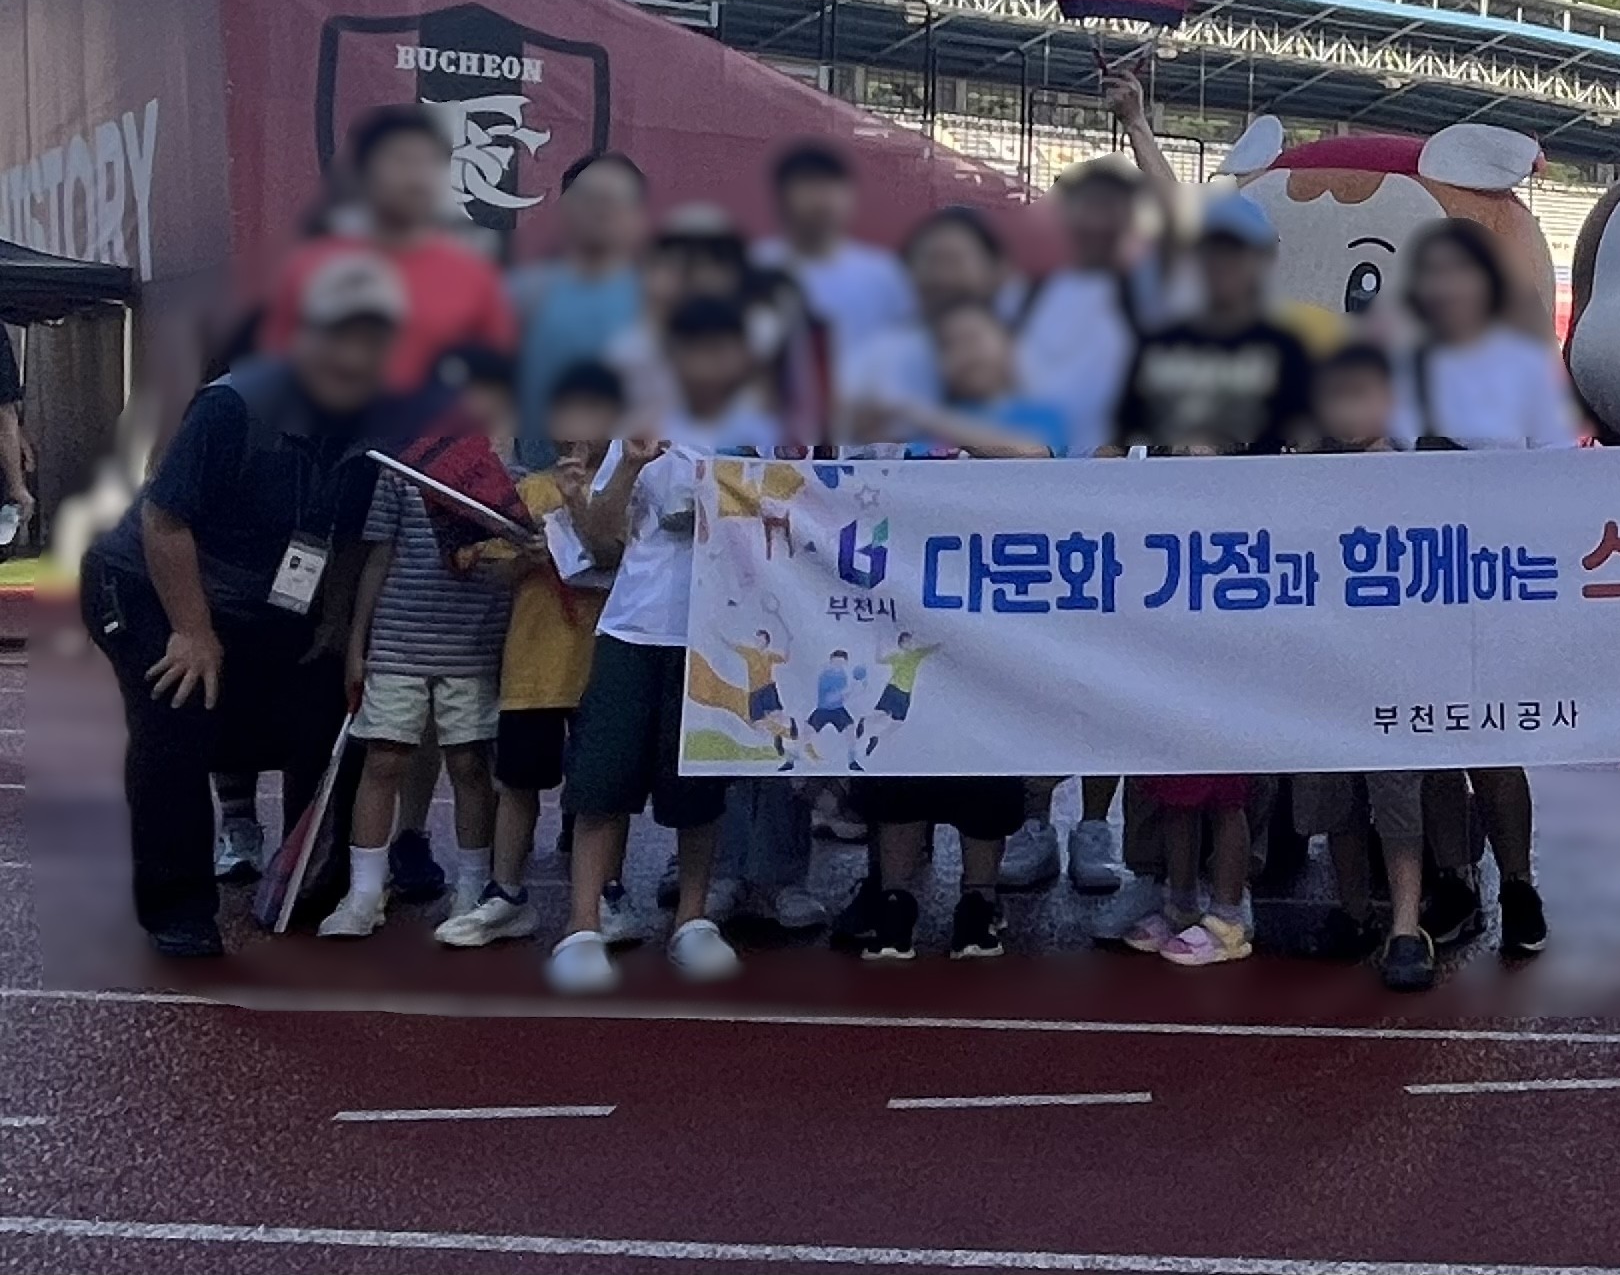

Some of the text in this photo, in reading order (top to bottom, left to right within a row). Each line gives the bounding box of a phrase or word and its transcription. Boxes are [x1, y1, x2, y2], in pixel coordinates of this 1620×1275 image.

[395, 44, 544, 84] BUCHEON
[923, 531, 1122, 613] 다문화
[1144, 528, 1320, 612] 가정과
[1339, 524, 1559, 608] 함께하는
[826, 596, 896, 622] 부천시
[1374, 700, 1579, 734] 부천도시공사
